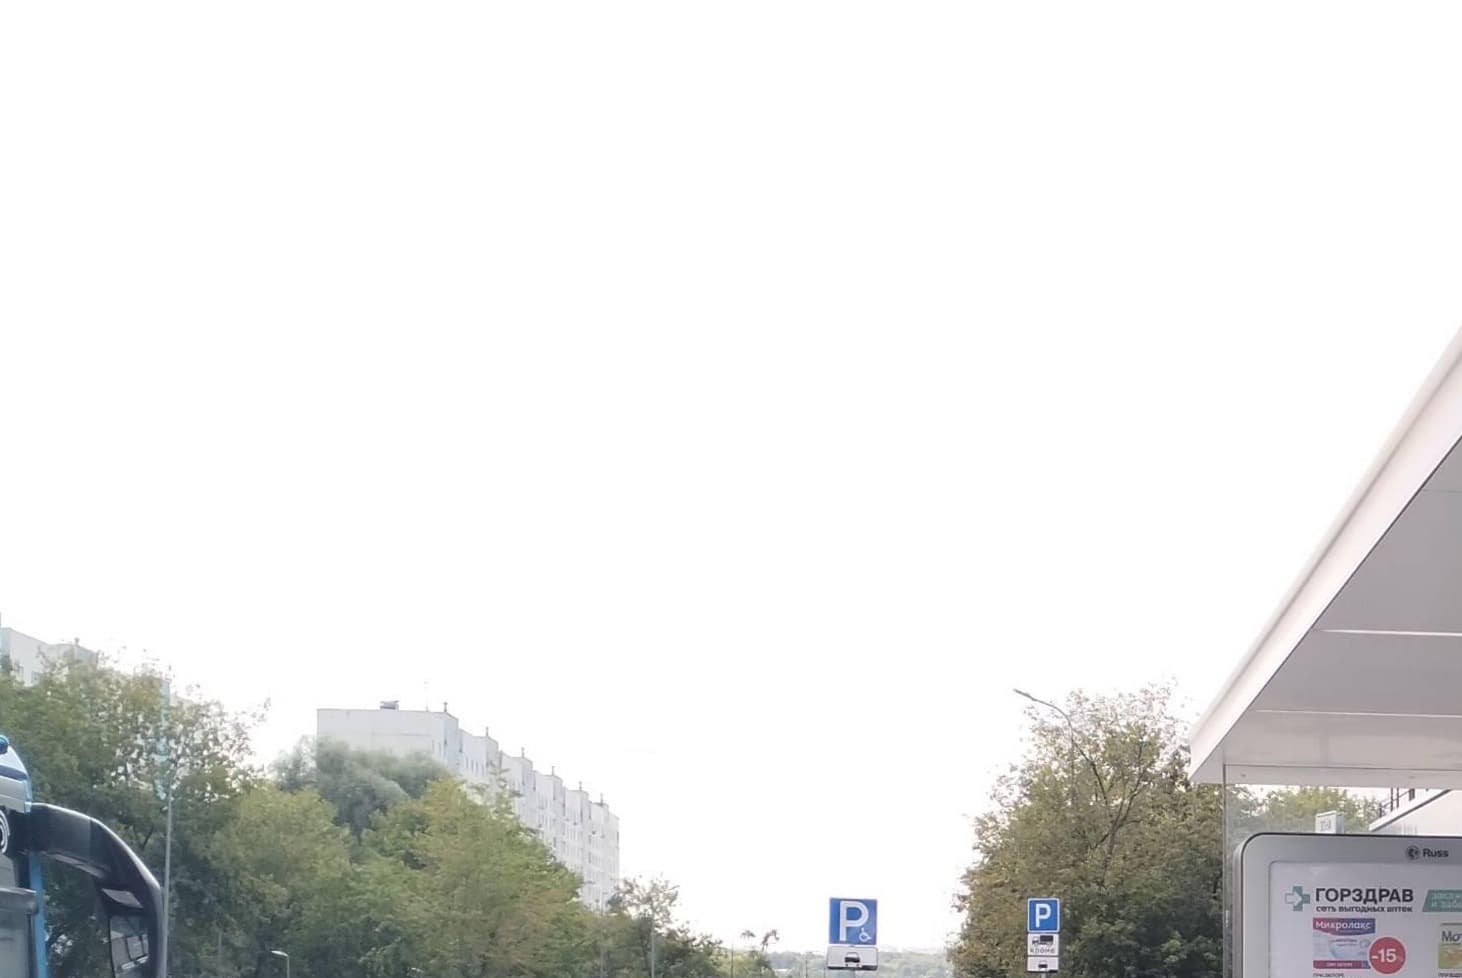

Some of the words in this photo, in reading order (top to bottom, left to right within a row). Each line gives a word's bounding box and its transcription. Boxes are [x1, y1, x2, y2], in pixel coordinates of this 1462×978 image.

[1423, 848, 1449, 858] Russ
[1315, 888, 1415, 905] ГОРЗДРАВ
[1035, 903, 1052, 928] P
[1338, 905, 1386, 914] выгодных
[840, 900, 869, 941] P
[1315, 921, 1372, 931] Микролакс
